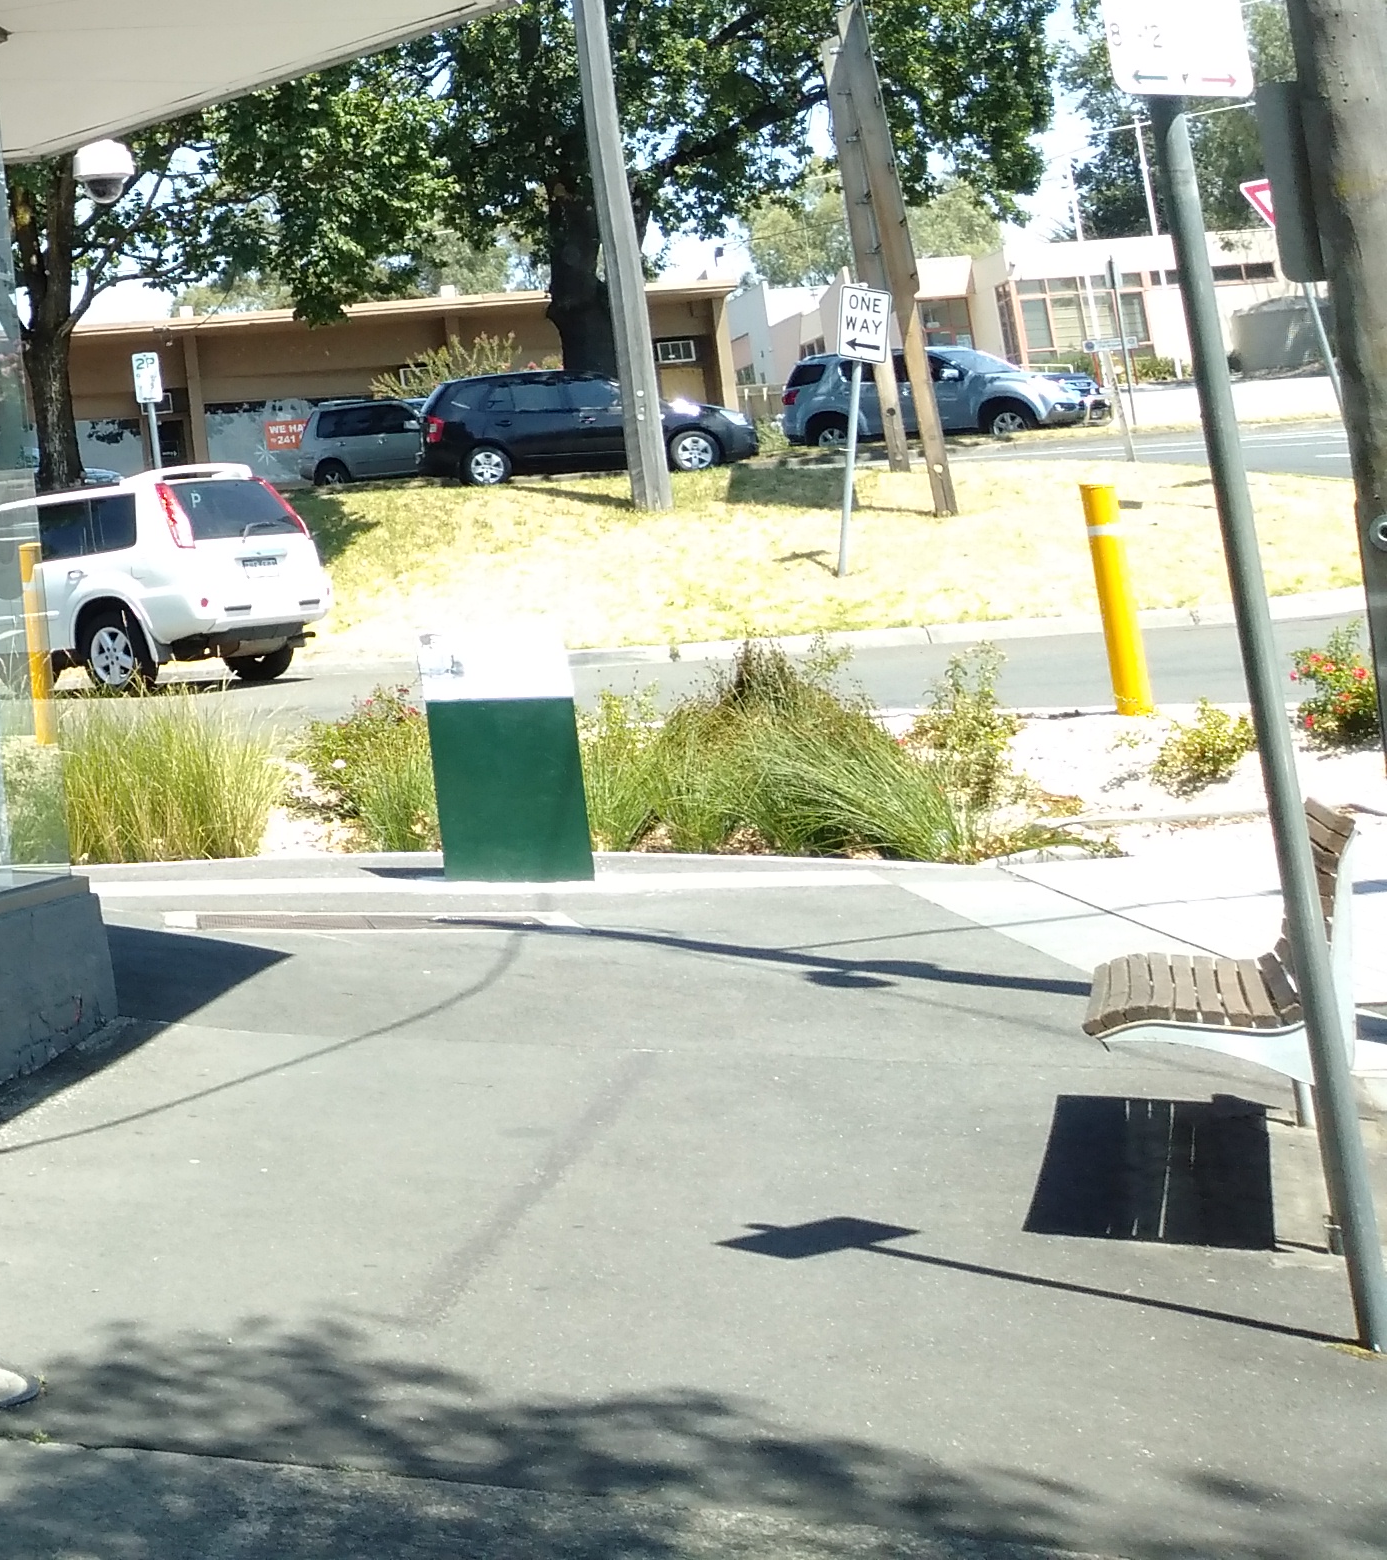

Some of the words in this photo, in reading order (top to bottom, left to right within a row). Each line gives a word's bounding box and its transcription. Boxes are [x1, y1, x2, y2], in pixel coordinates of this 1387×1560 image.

[849, 294, 882, 314] ONE
[846, 316, 883, 335] WAY
[135, 357, 155, 370] 2P
[268, 424, 287, 434] WE
[289, 423, 306, 434] HA
[277, 435, 296, 445] 241
